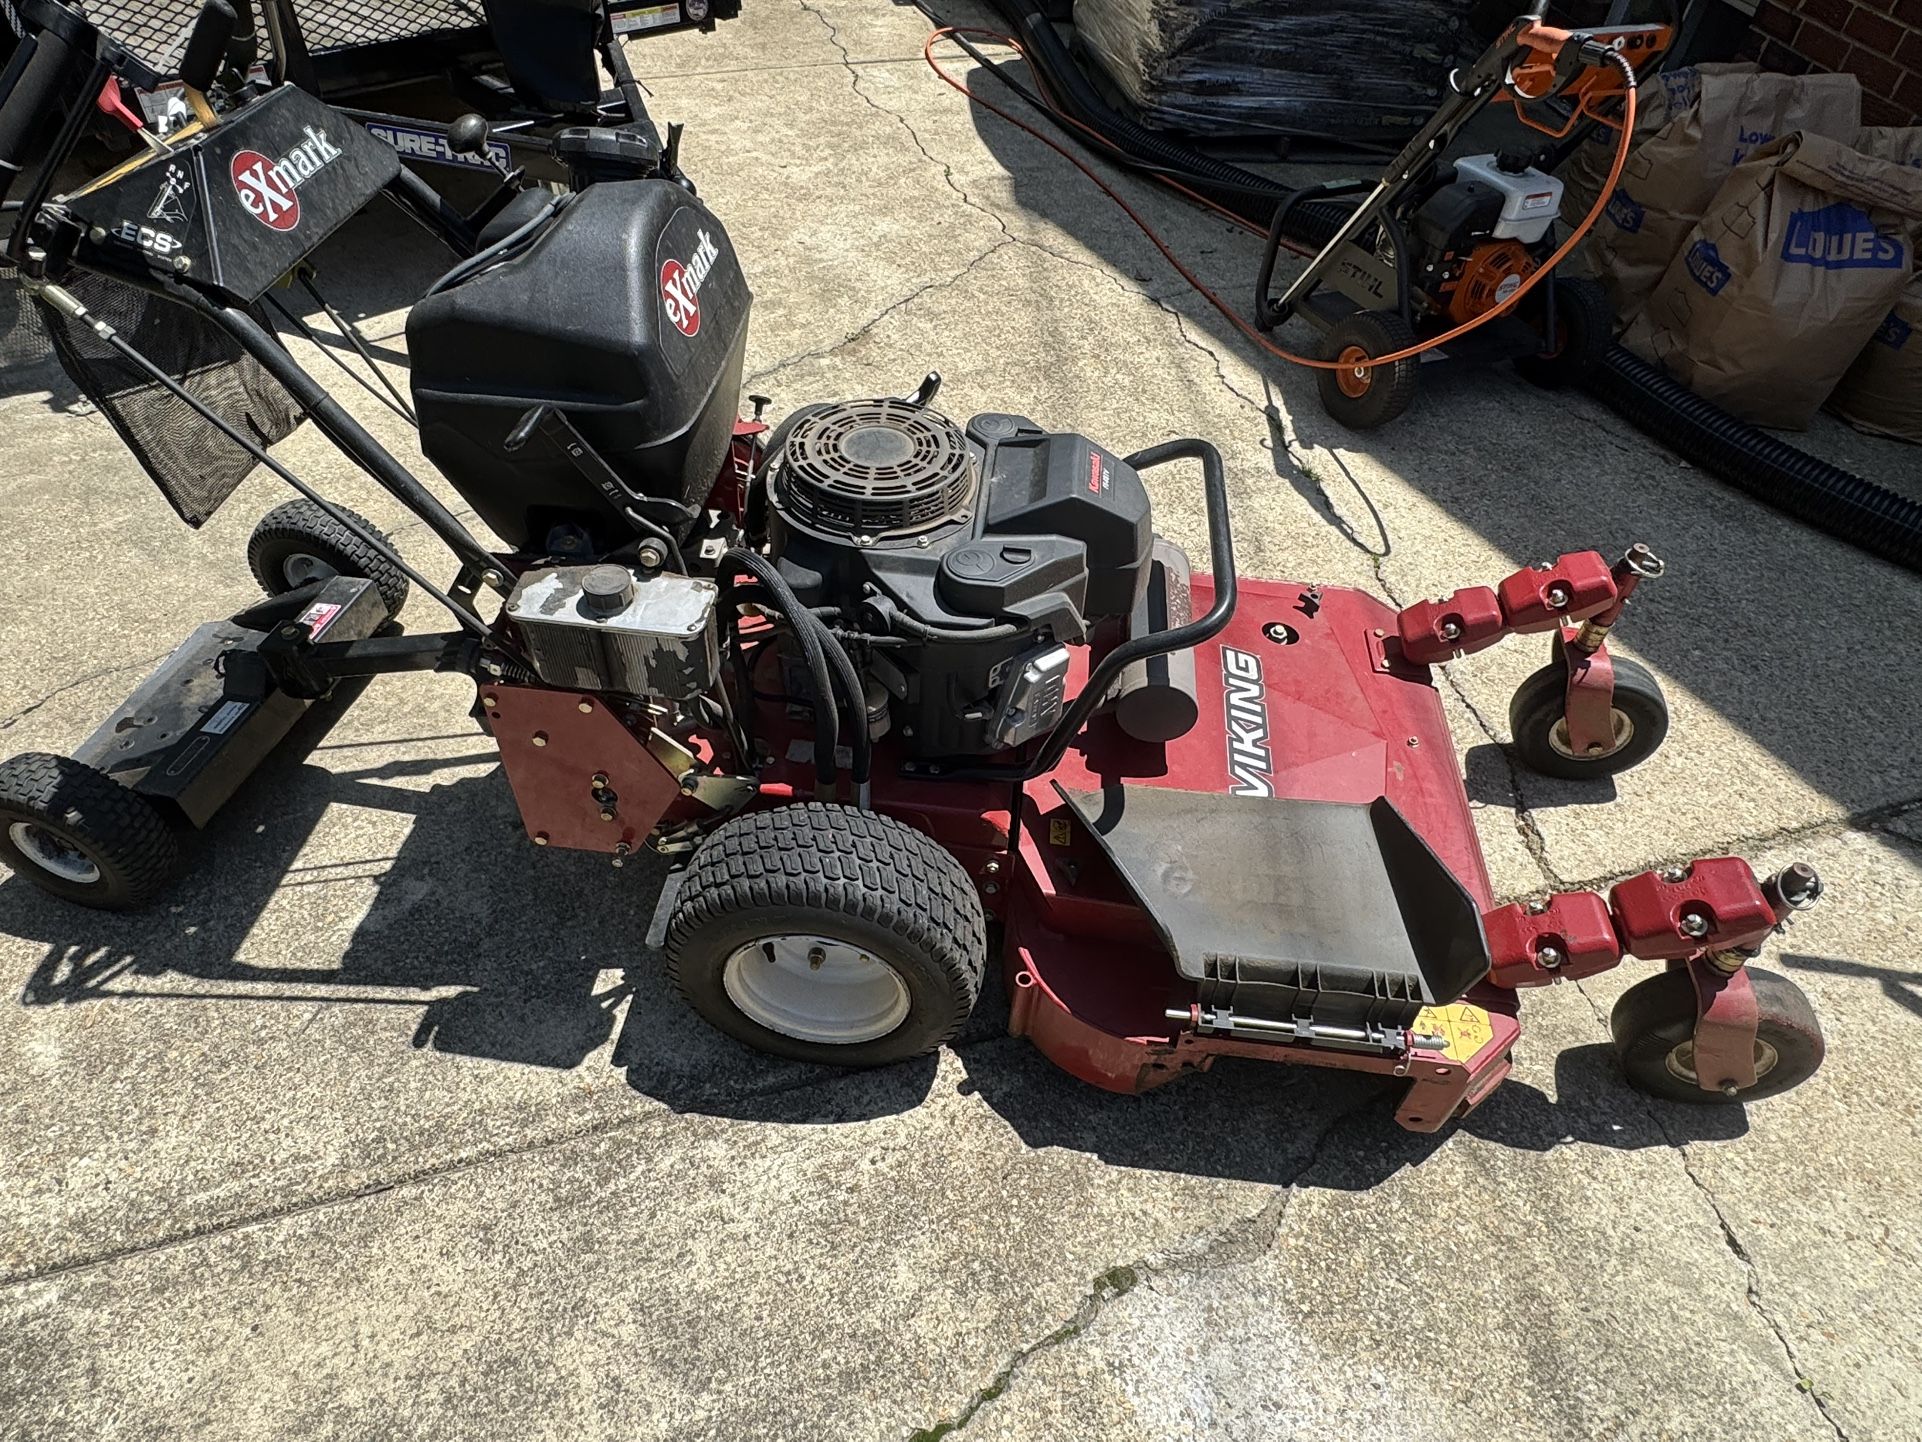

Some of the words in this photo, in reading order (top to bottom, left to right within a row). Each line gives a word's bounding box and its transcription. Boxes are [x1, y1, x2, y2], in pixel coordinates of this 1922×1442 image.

[168, 164, 176, 173] R
[176, 169, 184, 179] N
[183, 181, 191, 190] F
[237, 124, 342, 223] eXmark
[120, 221, 173, 254] ECS
[664, 228, 719, 330] eXmark
[1338, 259, 1384, 299] STIHL
[1220, 645, 1275, 798] VIKING
